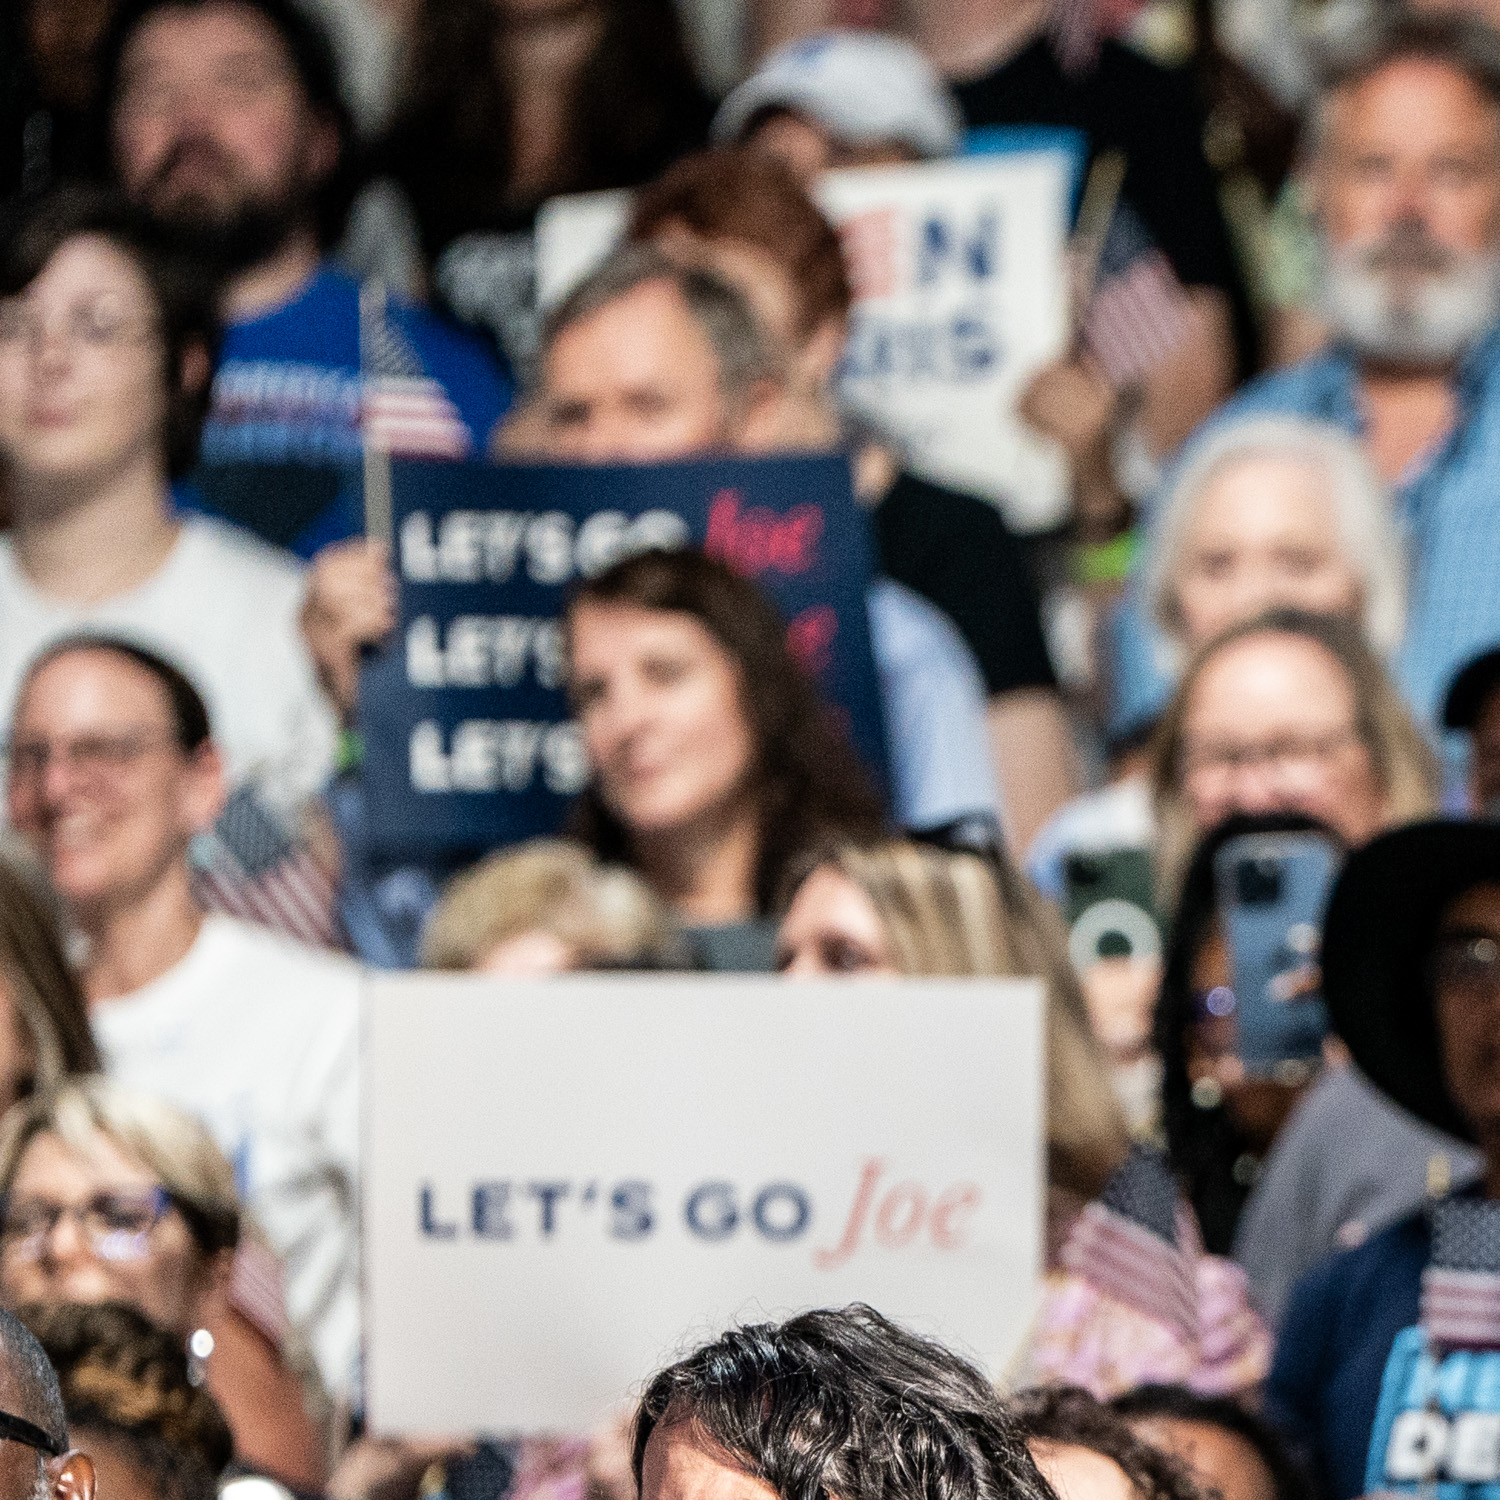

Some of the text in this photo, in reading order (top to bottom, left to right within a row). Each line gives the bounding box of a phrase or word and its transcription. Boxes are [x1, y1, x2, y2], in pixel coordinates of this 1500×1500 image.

[402, 509, 574, 583] LET'S
[418, 1156, 982, 1270] LET'S GO Joe
